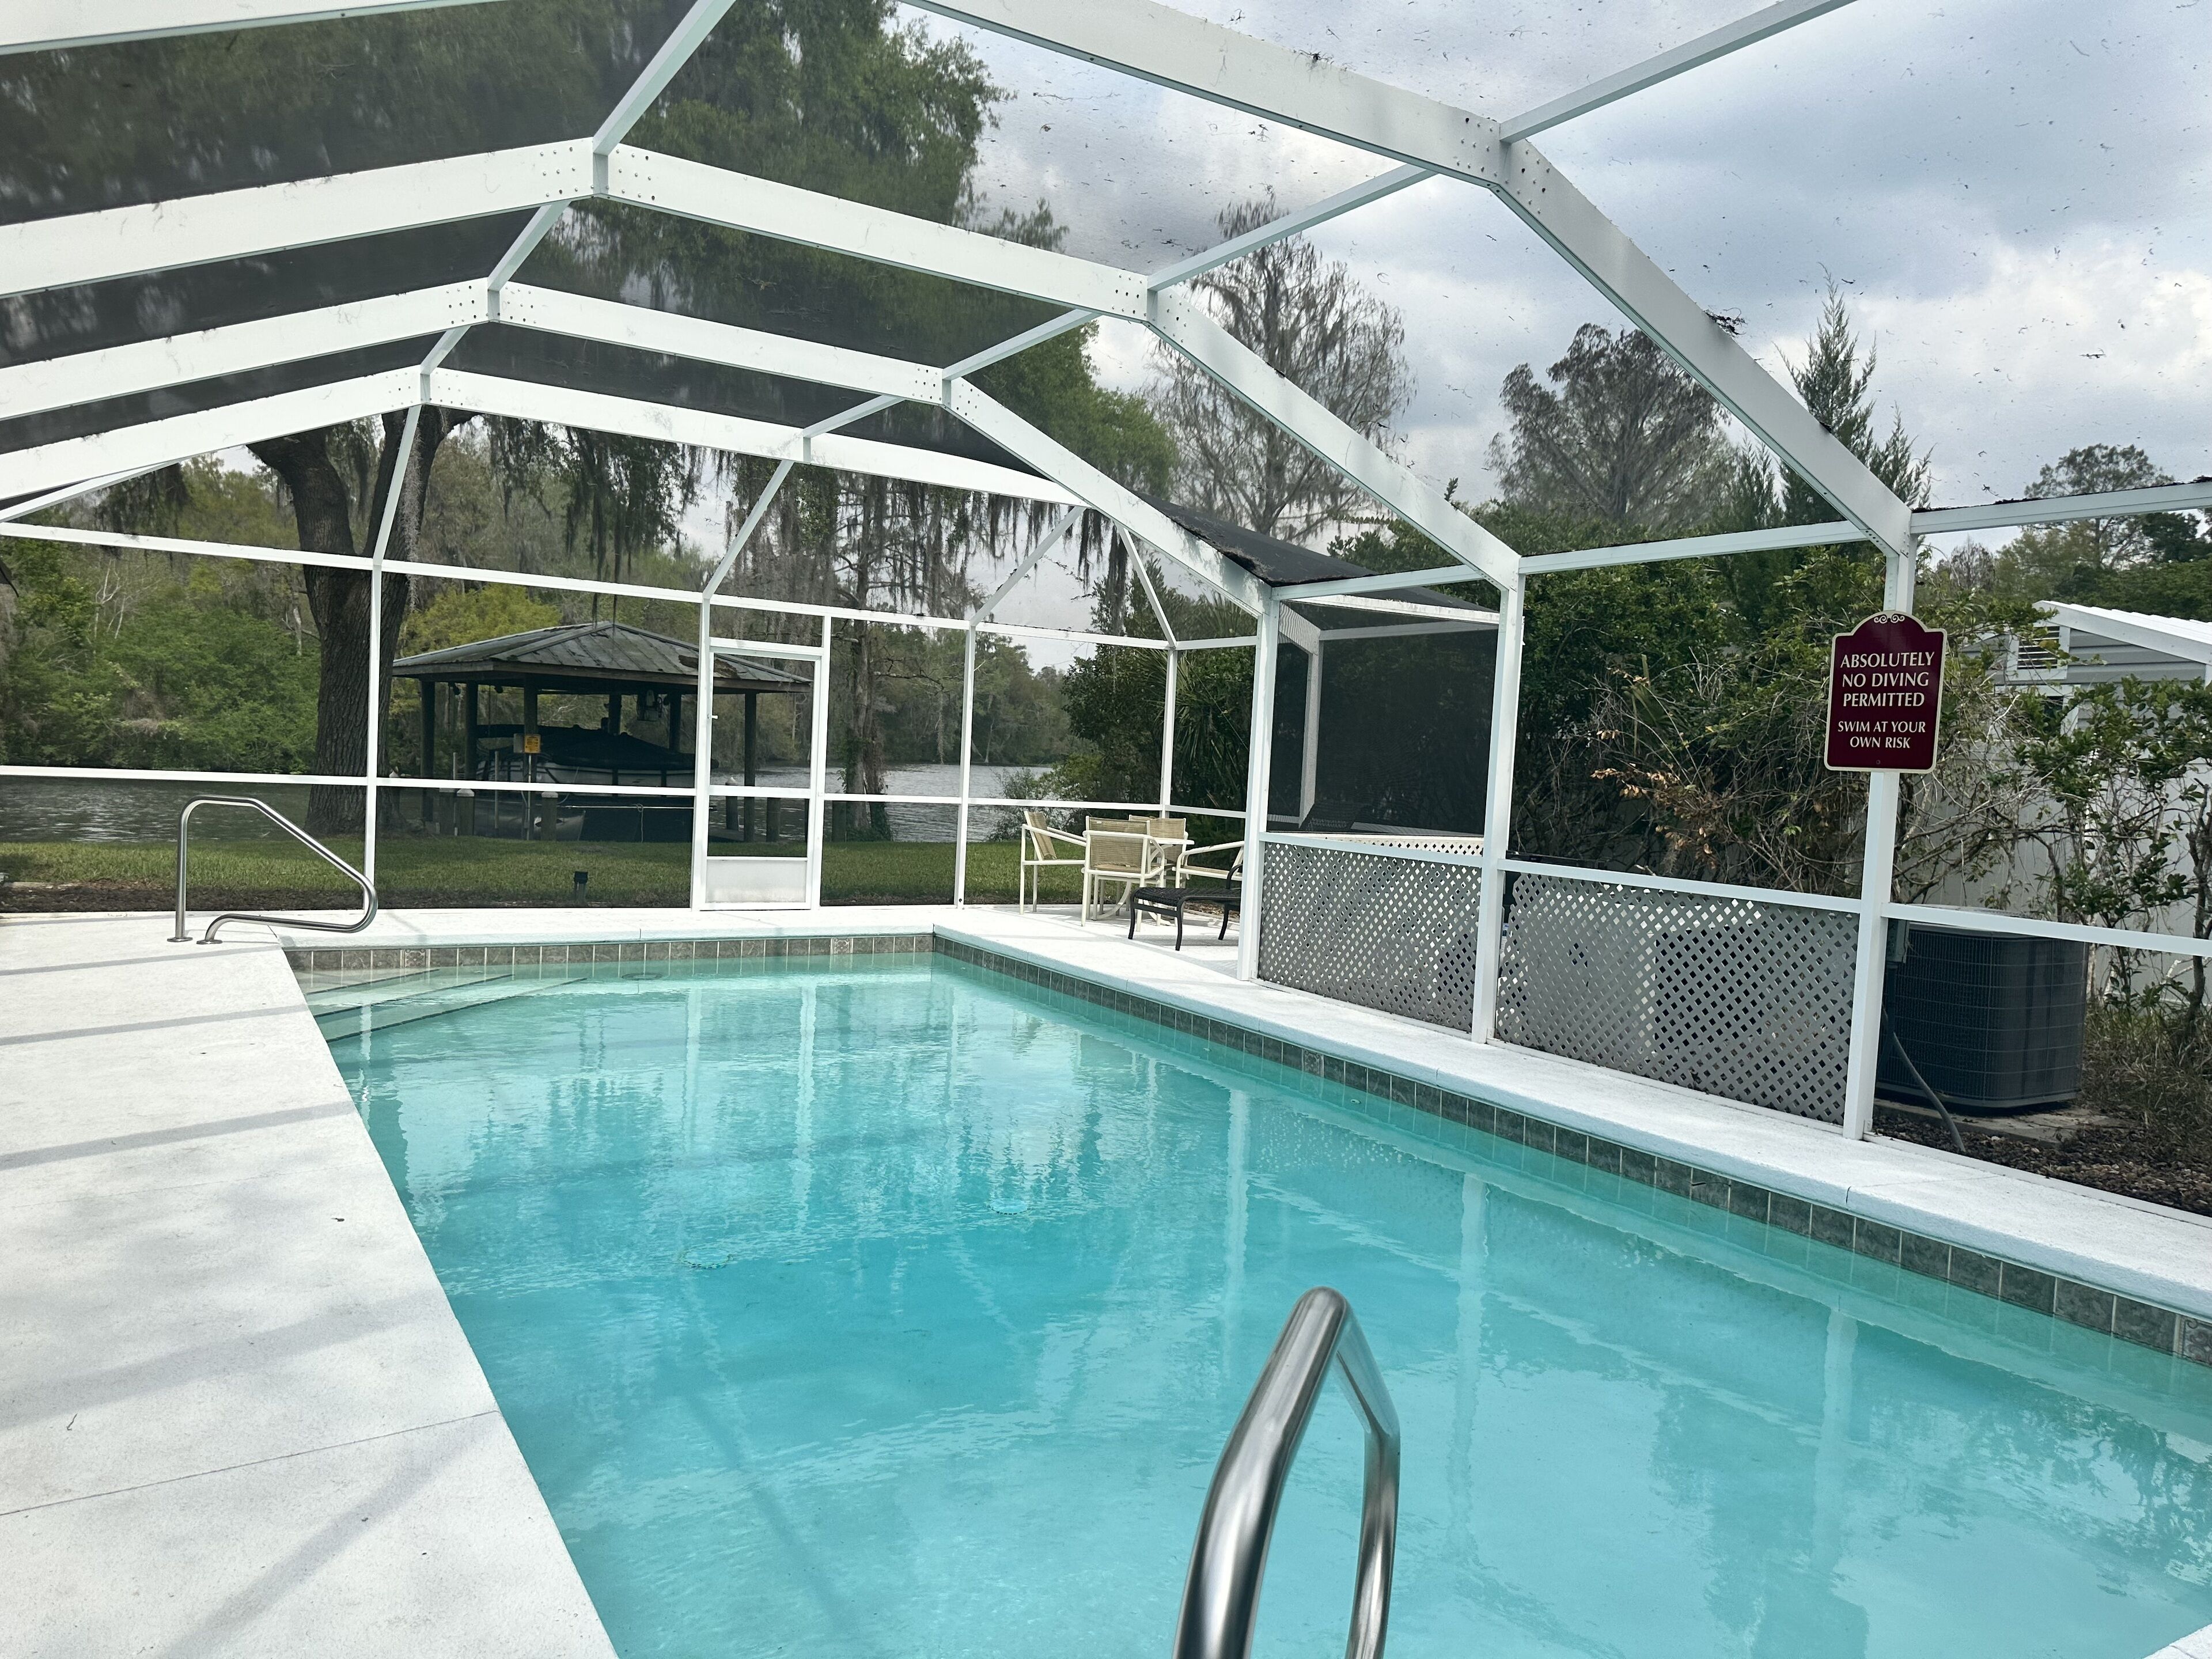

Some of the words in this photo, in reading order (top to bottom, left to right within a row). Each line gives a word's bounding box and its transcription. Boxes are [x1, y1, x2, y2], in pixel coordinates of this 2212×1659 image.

[1840, 652, 1934, 668] ABSOLUTELY
[1843, 673, 1866, 687] NO
[1872, 672, 1929, 687] DIVING
[1843, 692, 1924, 706] PERMITTED
[1838, 721, 1869, 732] SWIM
[1873, 721, 1888, 732] AT
[1892, 721, 1925, 732] YOUR
[1850, 737, 1880, 747] OWN
[1885, 737, 1910, 748] RISK
